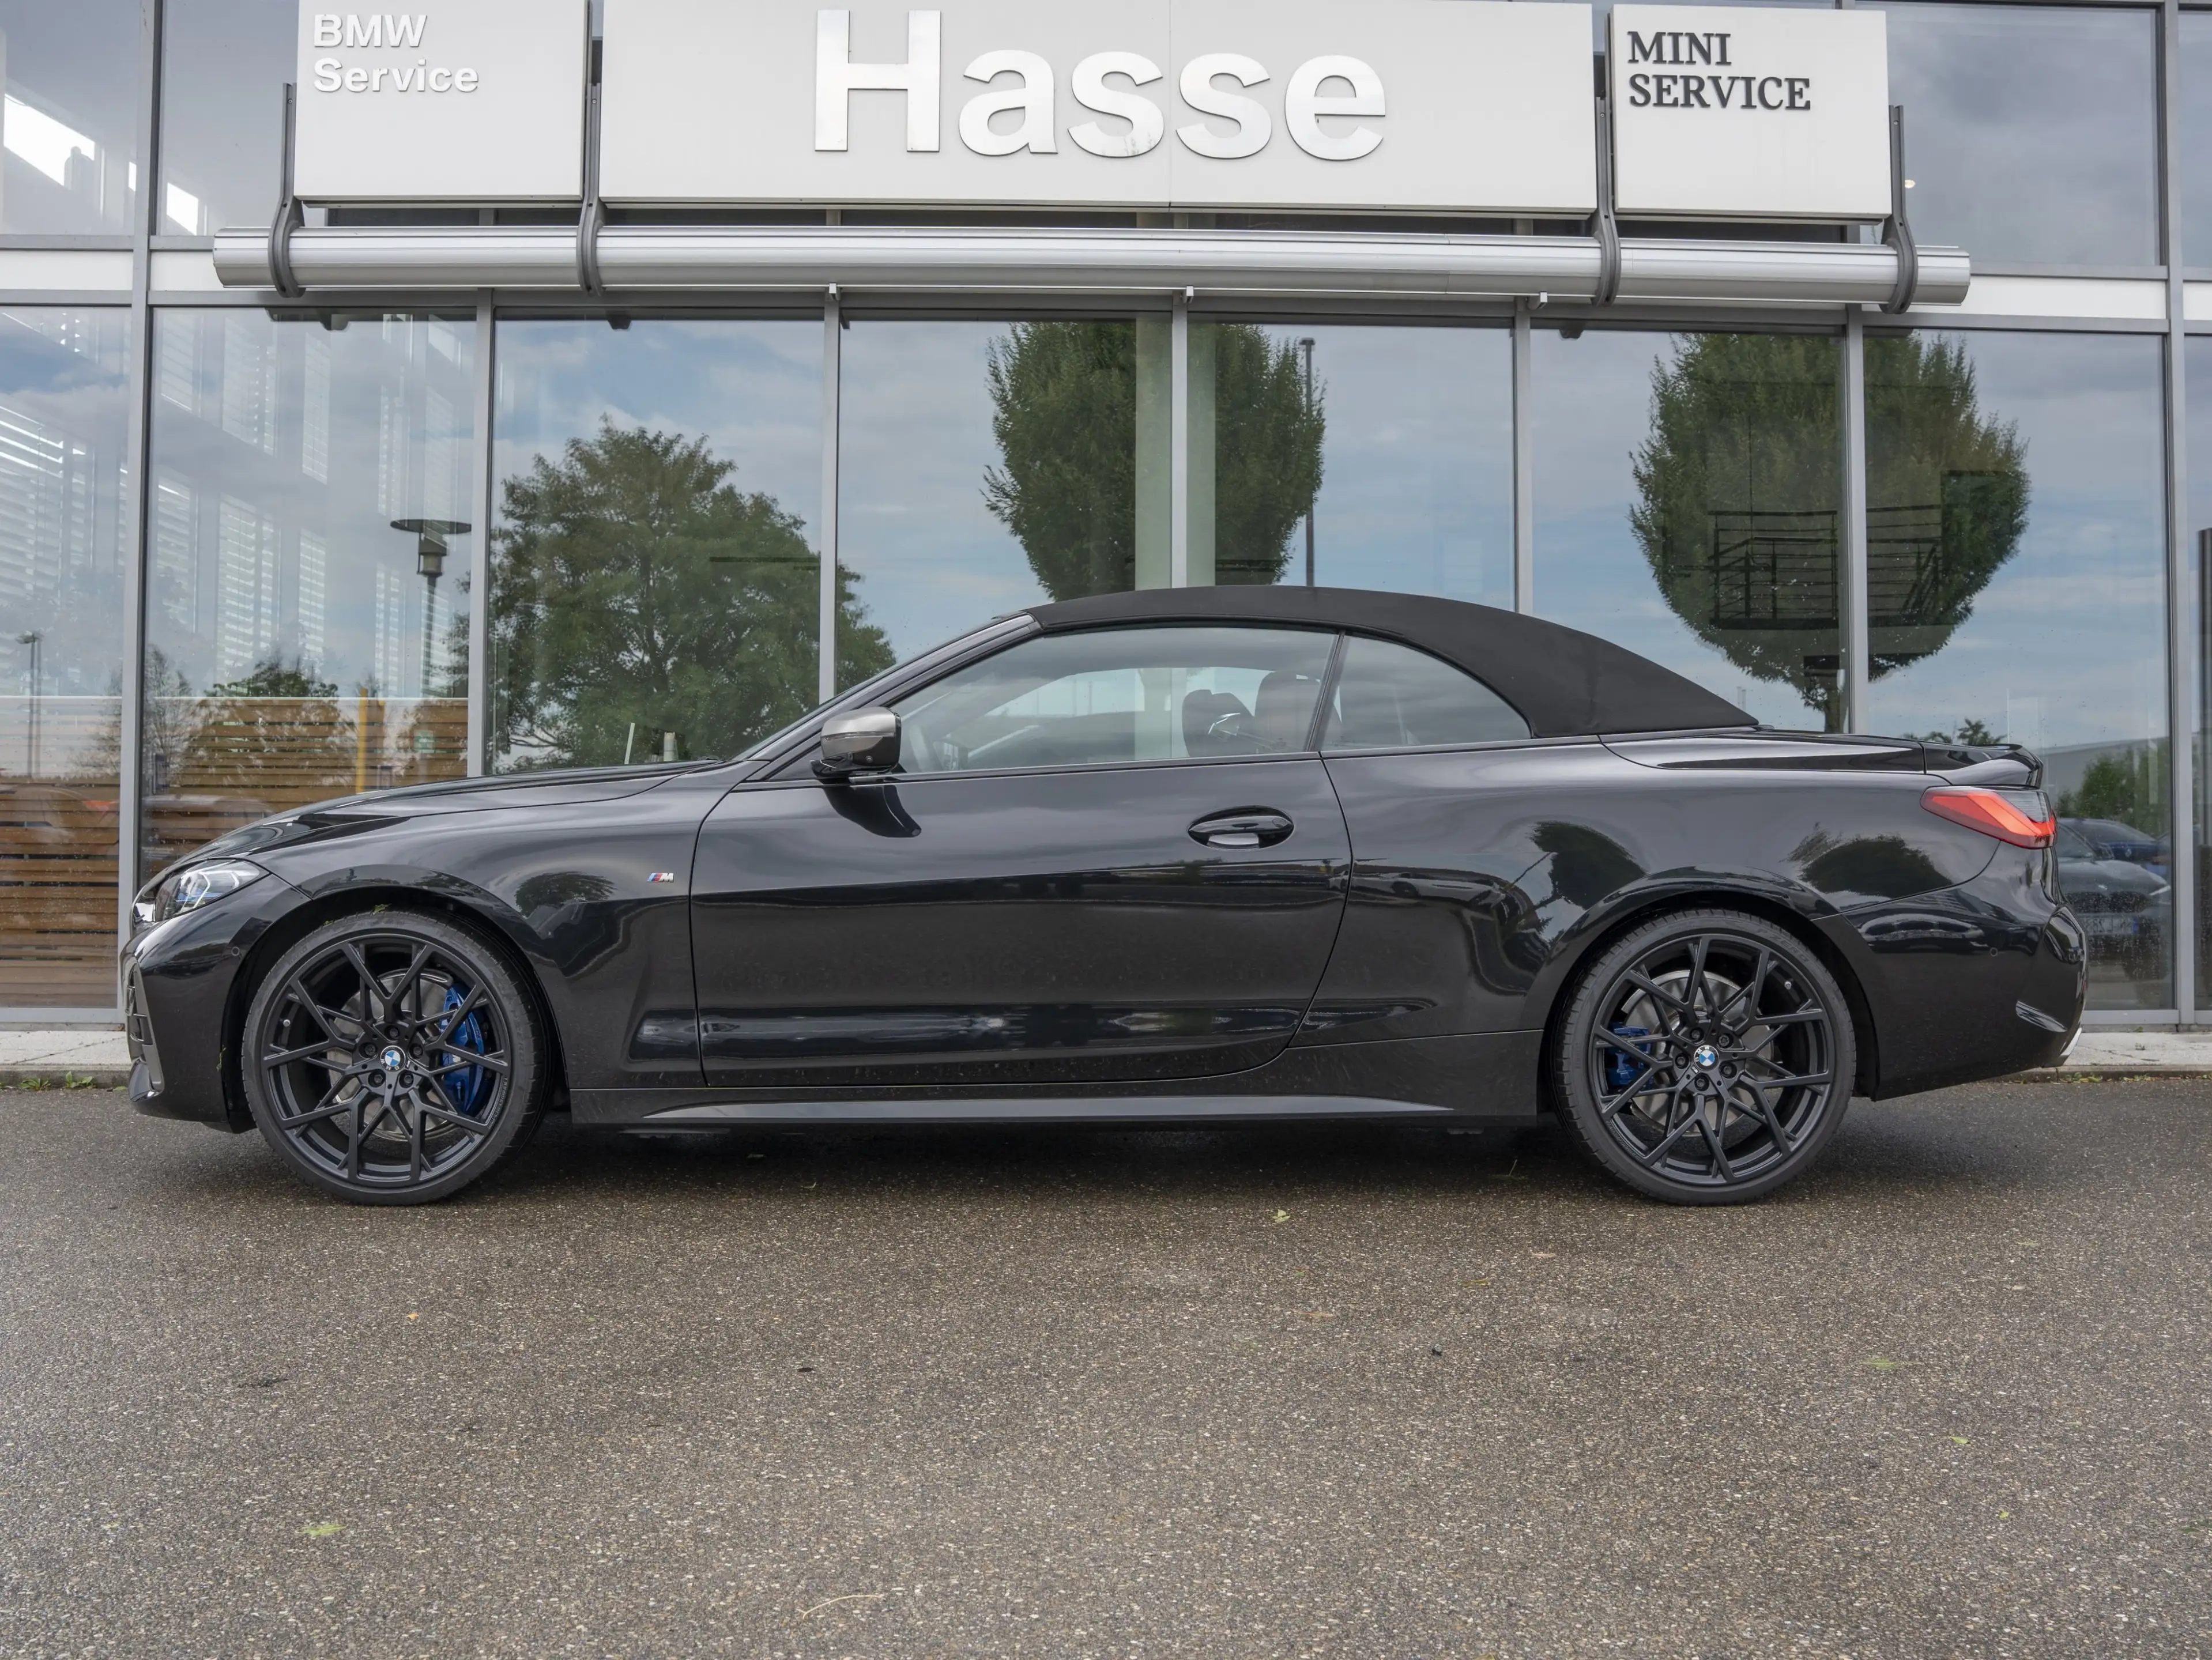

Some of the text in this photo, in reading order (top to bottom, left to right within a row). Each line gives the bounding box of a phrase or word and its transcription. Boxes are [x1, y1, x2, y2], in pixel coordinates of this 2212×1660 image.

[314, 14, 427, 47] BMW
[1627, 31, 1731, 66] MINI
[313, 58, 479, 92] Service
[815, 9, 1386, 161] Hasse
[1629, 73, 1811, 110] SERVICE
